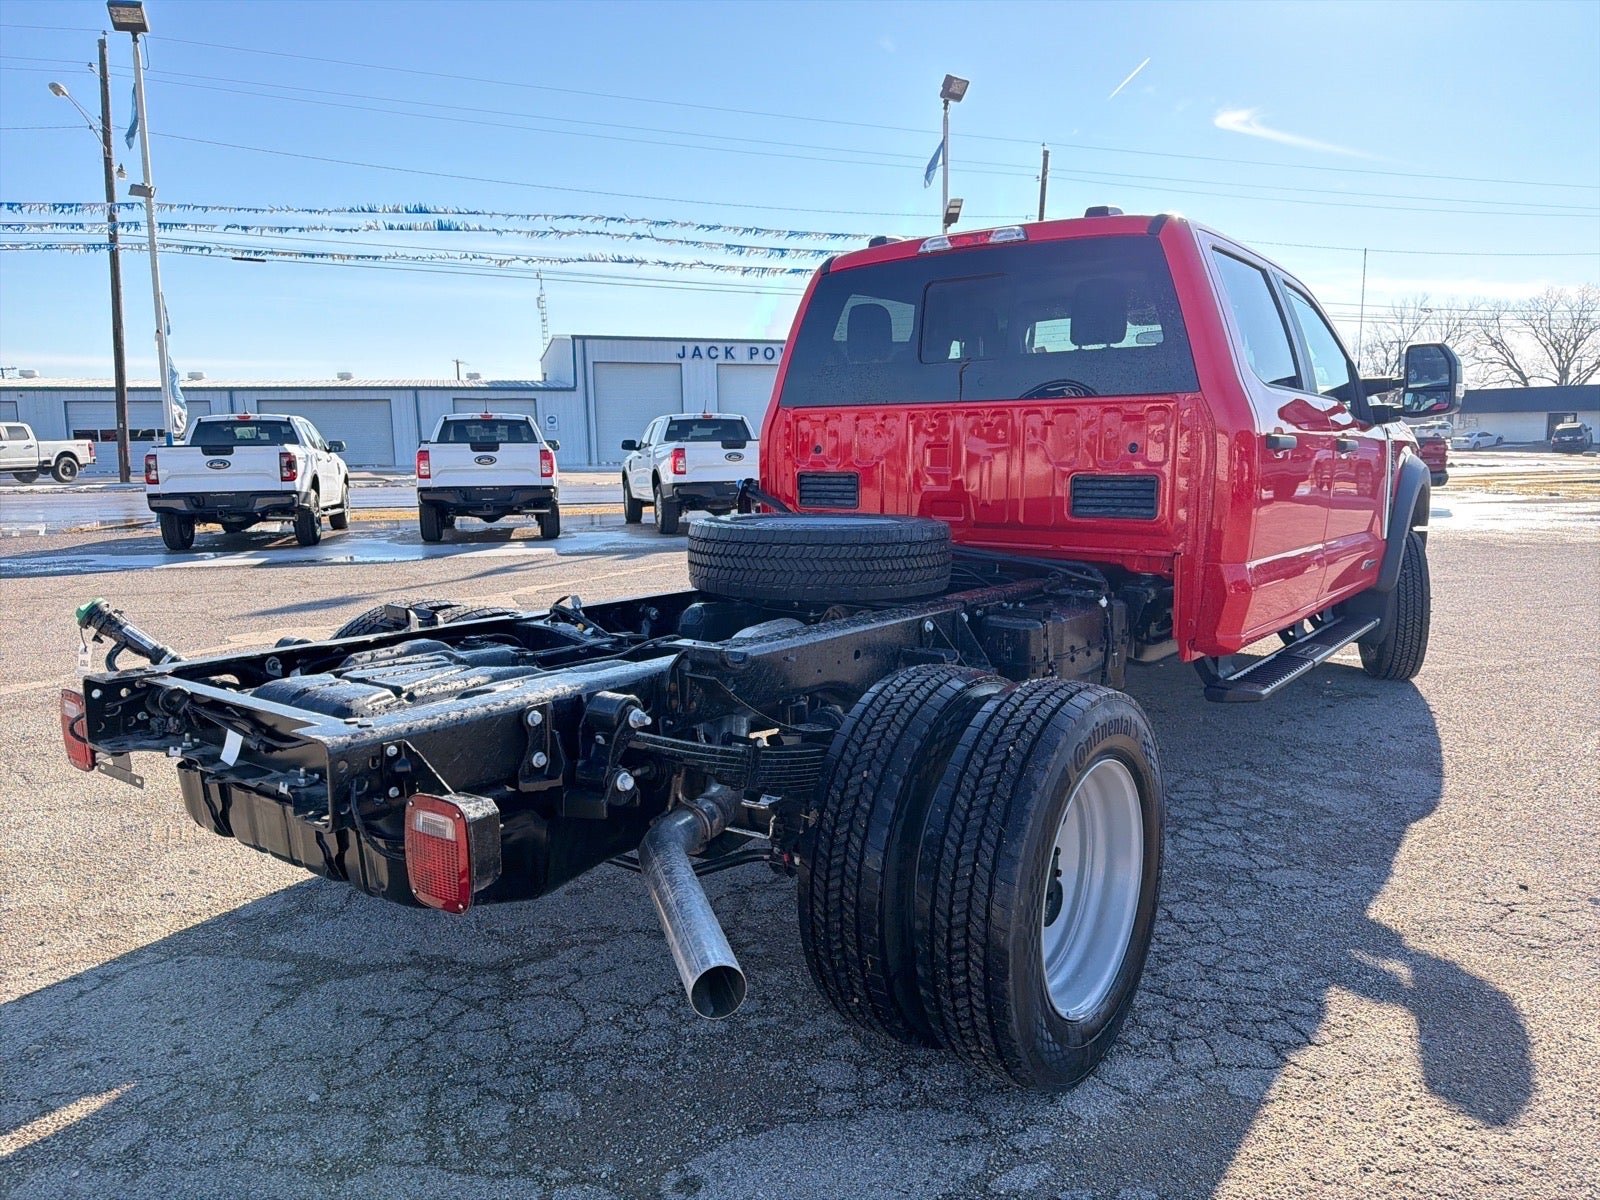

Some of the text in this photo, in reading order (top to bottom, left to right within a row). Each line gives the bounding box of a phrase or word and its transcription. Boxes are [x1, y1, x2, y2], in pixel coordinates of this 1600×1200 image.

[677, 345, 784, 361] JACK PO
[1073, 714, 1133, 773] Continental
